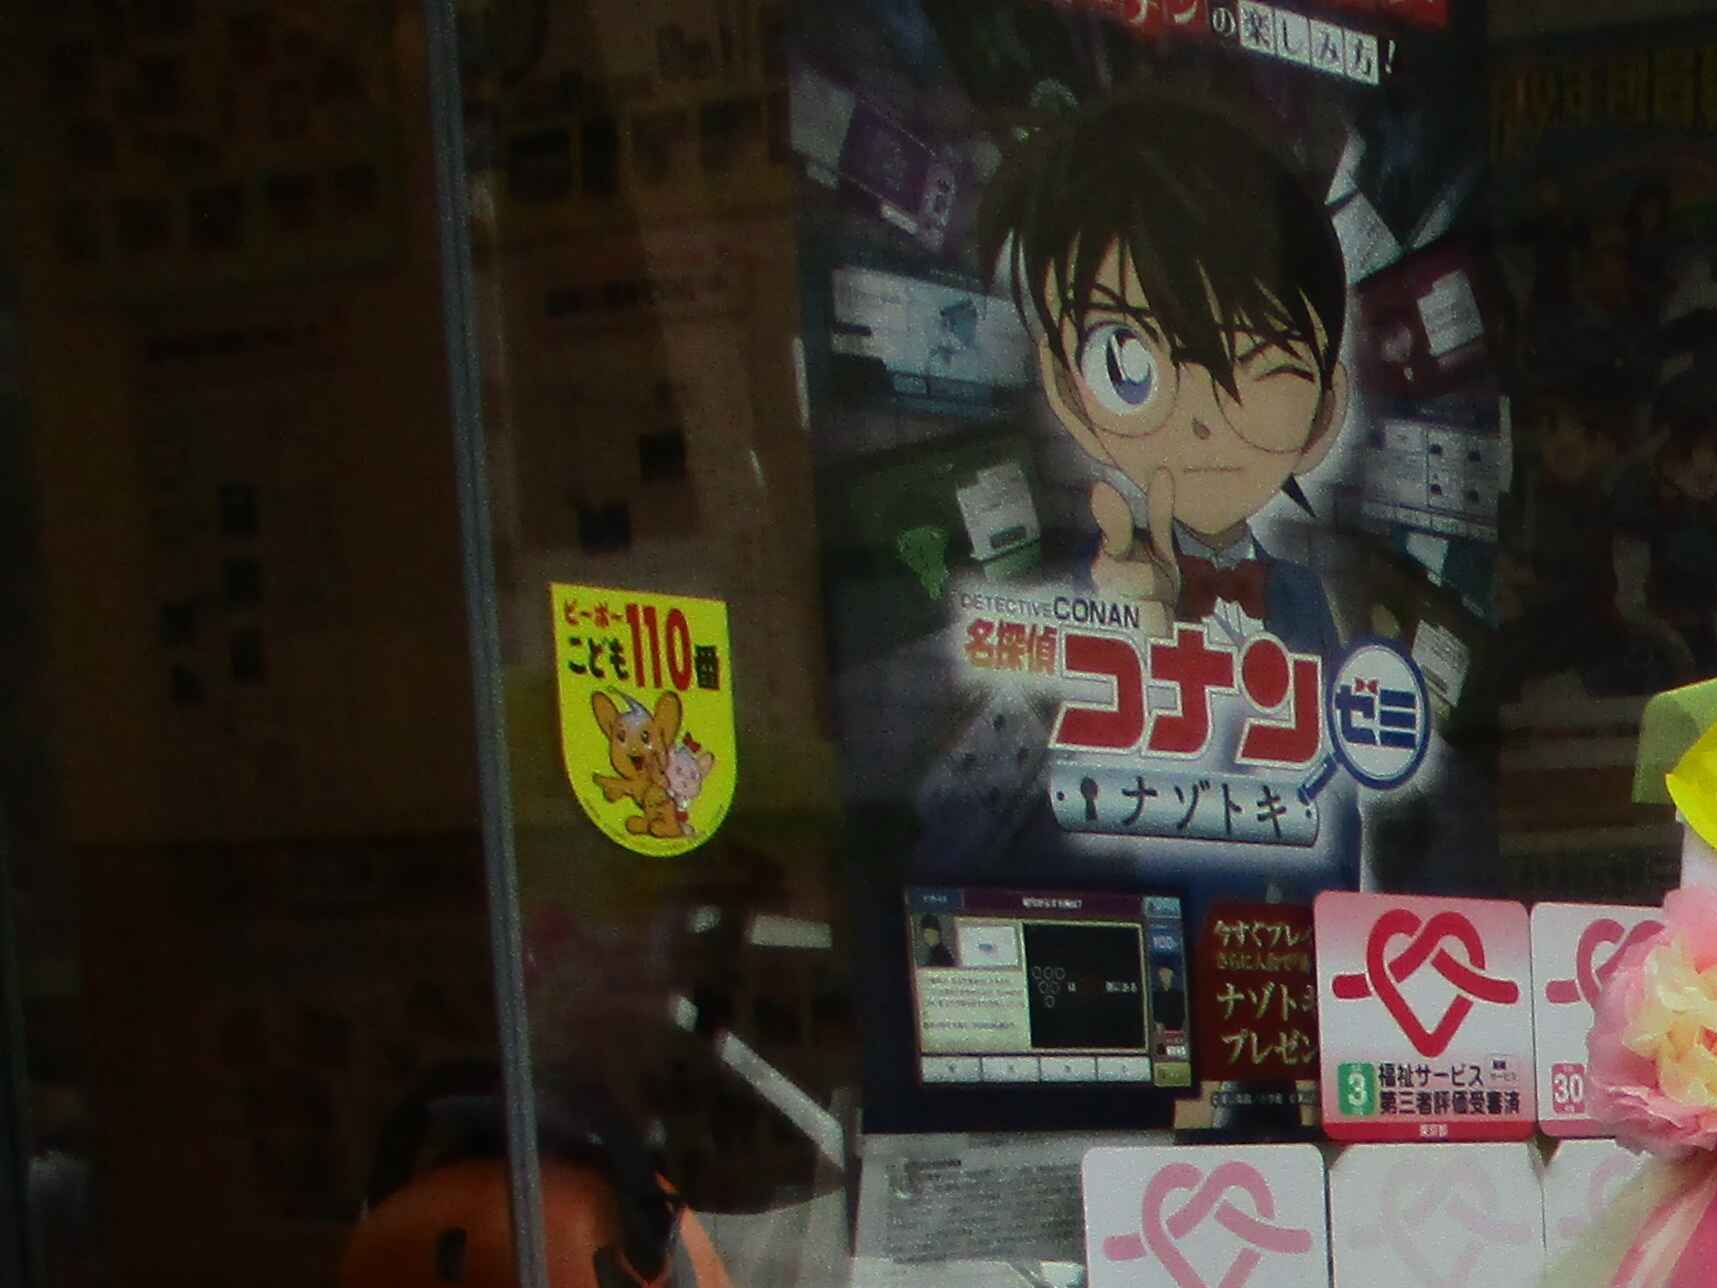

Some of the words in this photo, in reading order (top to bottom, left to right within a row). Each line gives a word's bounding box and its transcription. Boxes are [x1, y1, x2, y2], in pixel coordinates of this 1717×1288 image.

[1053, 597, 1140, 630] CONAN
[964, 617, 1058, 676] 名探偵
[1052, 621, 1322, 767] コナン
[1335, 674, 1417, 749] ゼミ
[1121, 775, 1287, 839] ナゾトキ
[1378, 1062, 1484, 1087] 福祉サービス
[1553, 1072, 1584, 1104] 30
[1380, 1090, 1520, 1116] 第三者評価受審済
